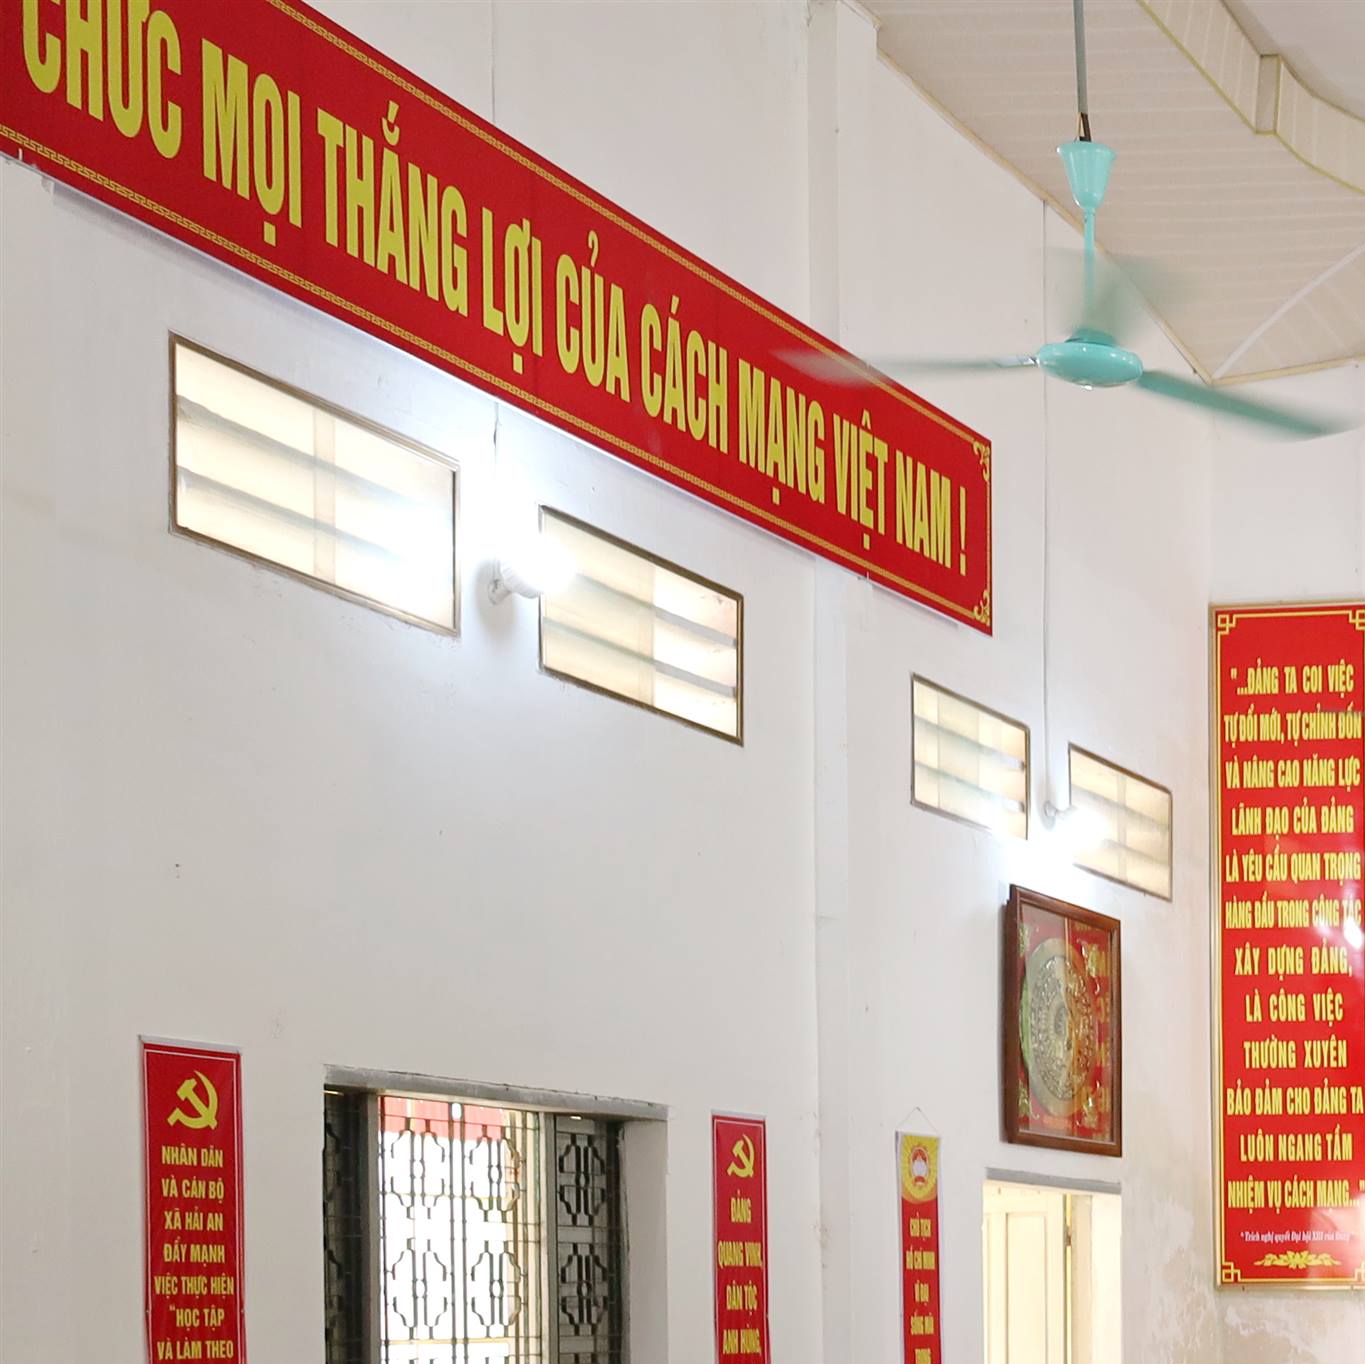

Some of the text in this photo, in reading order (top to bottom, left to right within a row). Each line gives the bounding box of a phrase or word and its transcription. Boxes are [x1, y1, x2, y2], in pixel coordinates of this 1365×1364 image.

[200, 37, 304, 248] MỌI
[315, 98, 471, 320] THẮNG
[479, 205, 545, 376] LỢI
[554, 230, 632, 403] CỦA
[637, 291, 730, 456] CÁCH
[736, 357, 827, 507] MẠNG
[832, 410, 889, 551] VIỆT
[894, 472, 954, 573] NAM
[1284, 667, 1297, 693] TA
[1303, 666, 1322, 693] COI
[1328, 659, 1353, 698] VIỆC
[1226, 754, 1360, 791] VÀ NÂNG CAO NĂNG LỰC
[1232, 797, 1354, 840] LÃNH ĐẠO CỦA ĐẢNG
[1226, 844, 1361, 887] LÀ YÊU CẦU QUAN TRỌNG
[1235, 937, 1353, 980] XÂY DỰNG ĐẢNG,
[1246, 988, 1343, 1026] LÀ CÔNG VIỆC
[1244, 1034, 1346, 1068] THƯỜNG XUYÊN
[1227, 1078, 1363, 1115] BẢO ĐẢM CHO ĐẢNG TA
[1241, 1124, 1352, 1161] LUÔN NGANG TẦM
[1228, 1175, 1264, 1213] NHIỆM
[1267, 1181, 1281, 1213] VỤ
[1285, 1175, 1314, 1208] CÁCH
